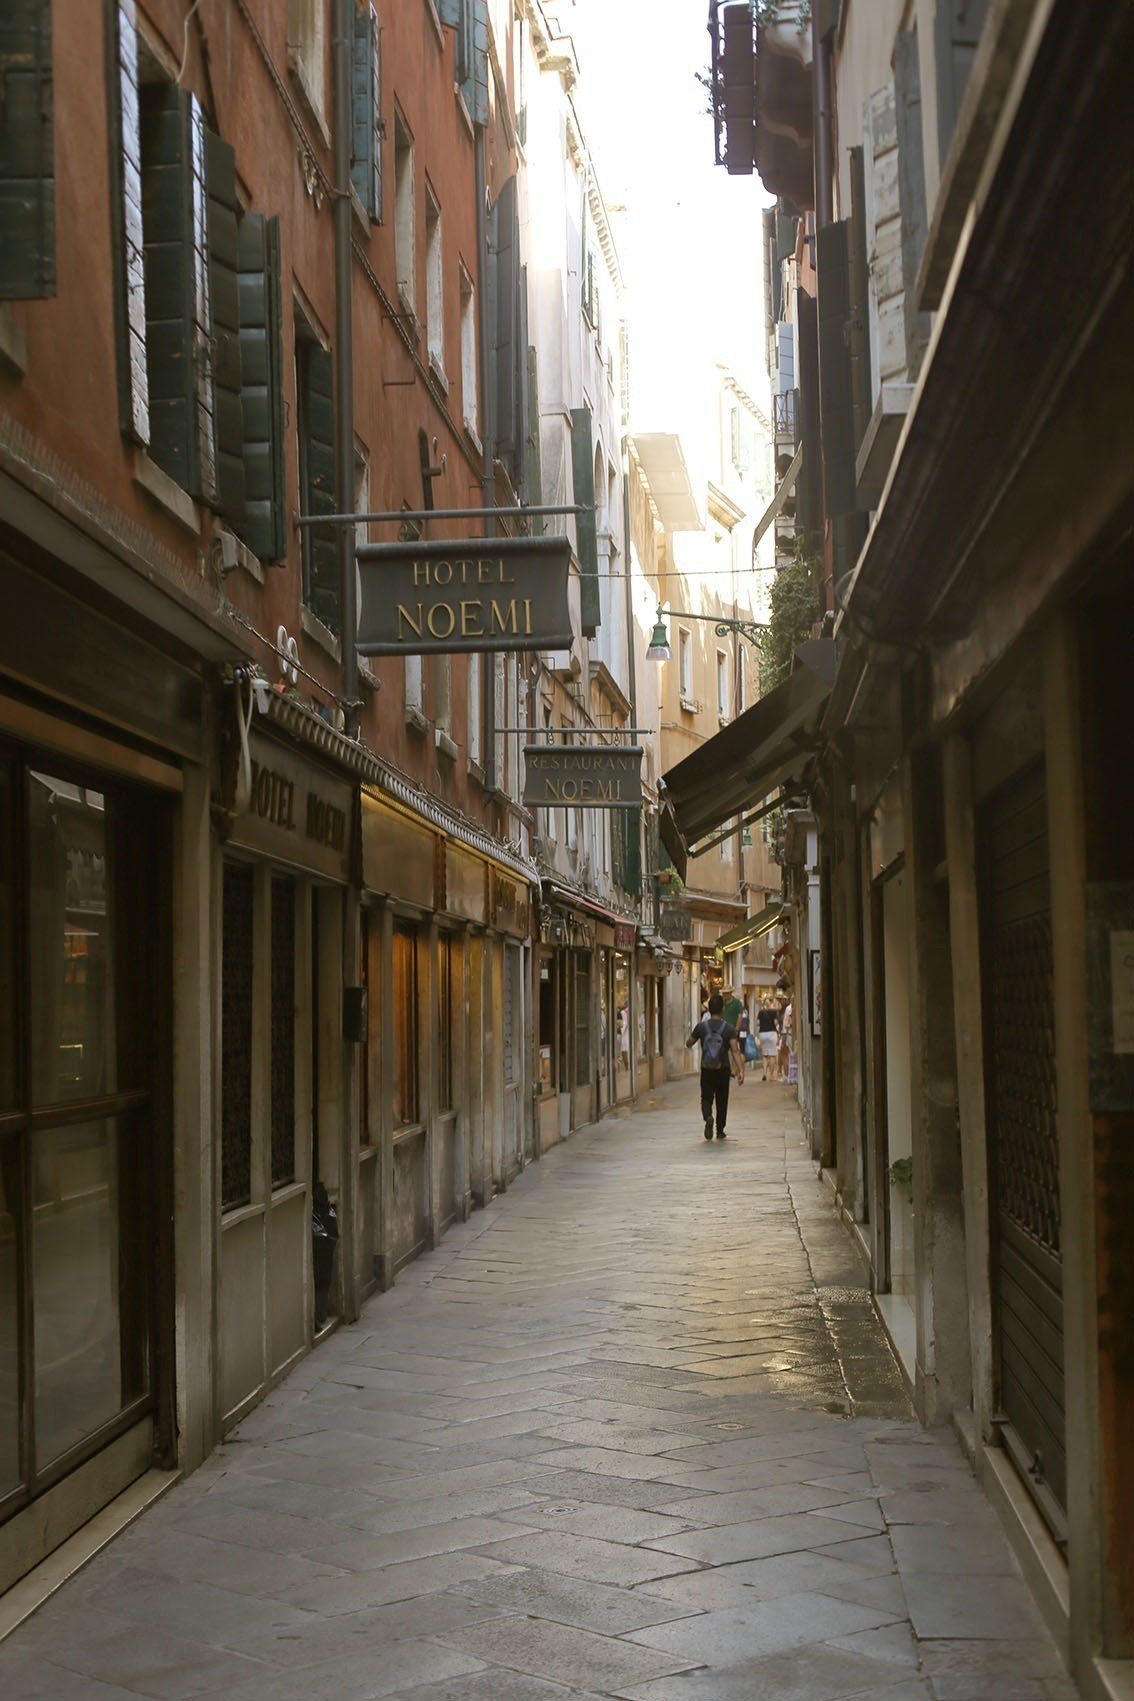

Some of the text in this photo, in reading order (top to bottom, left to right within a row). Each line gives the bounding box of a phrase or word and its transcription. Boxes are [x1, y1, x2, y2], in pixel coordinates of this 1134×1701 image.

[412, 559, 516, 587] HOTEL
[396, 598, 534, 641] NOEMI
[529, 754, 638, 771] RESTAURANT
[544, 778, 622, 801] NOEMI
